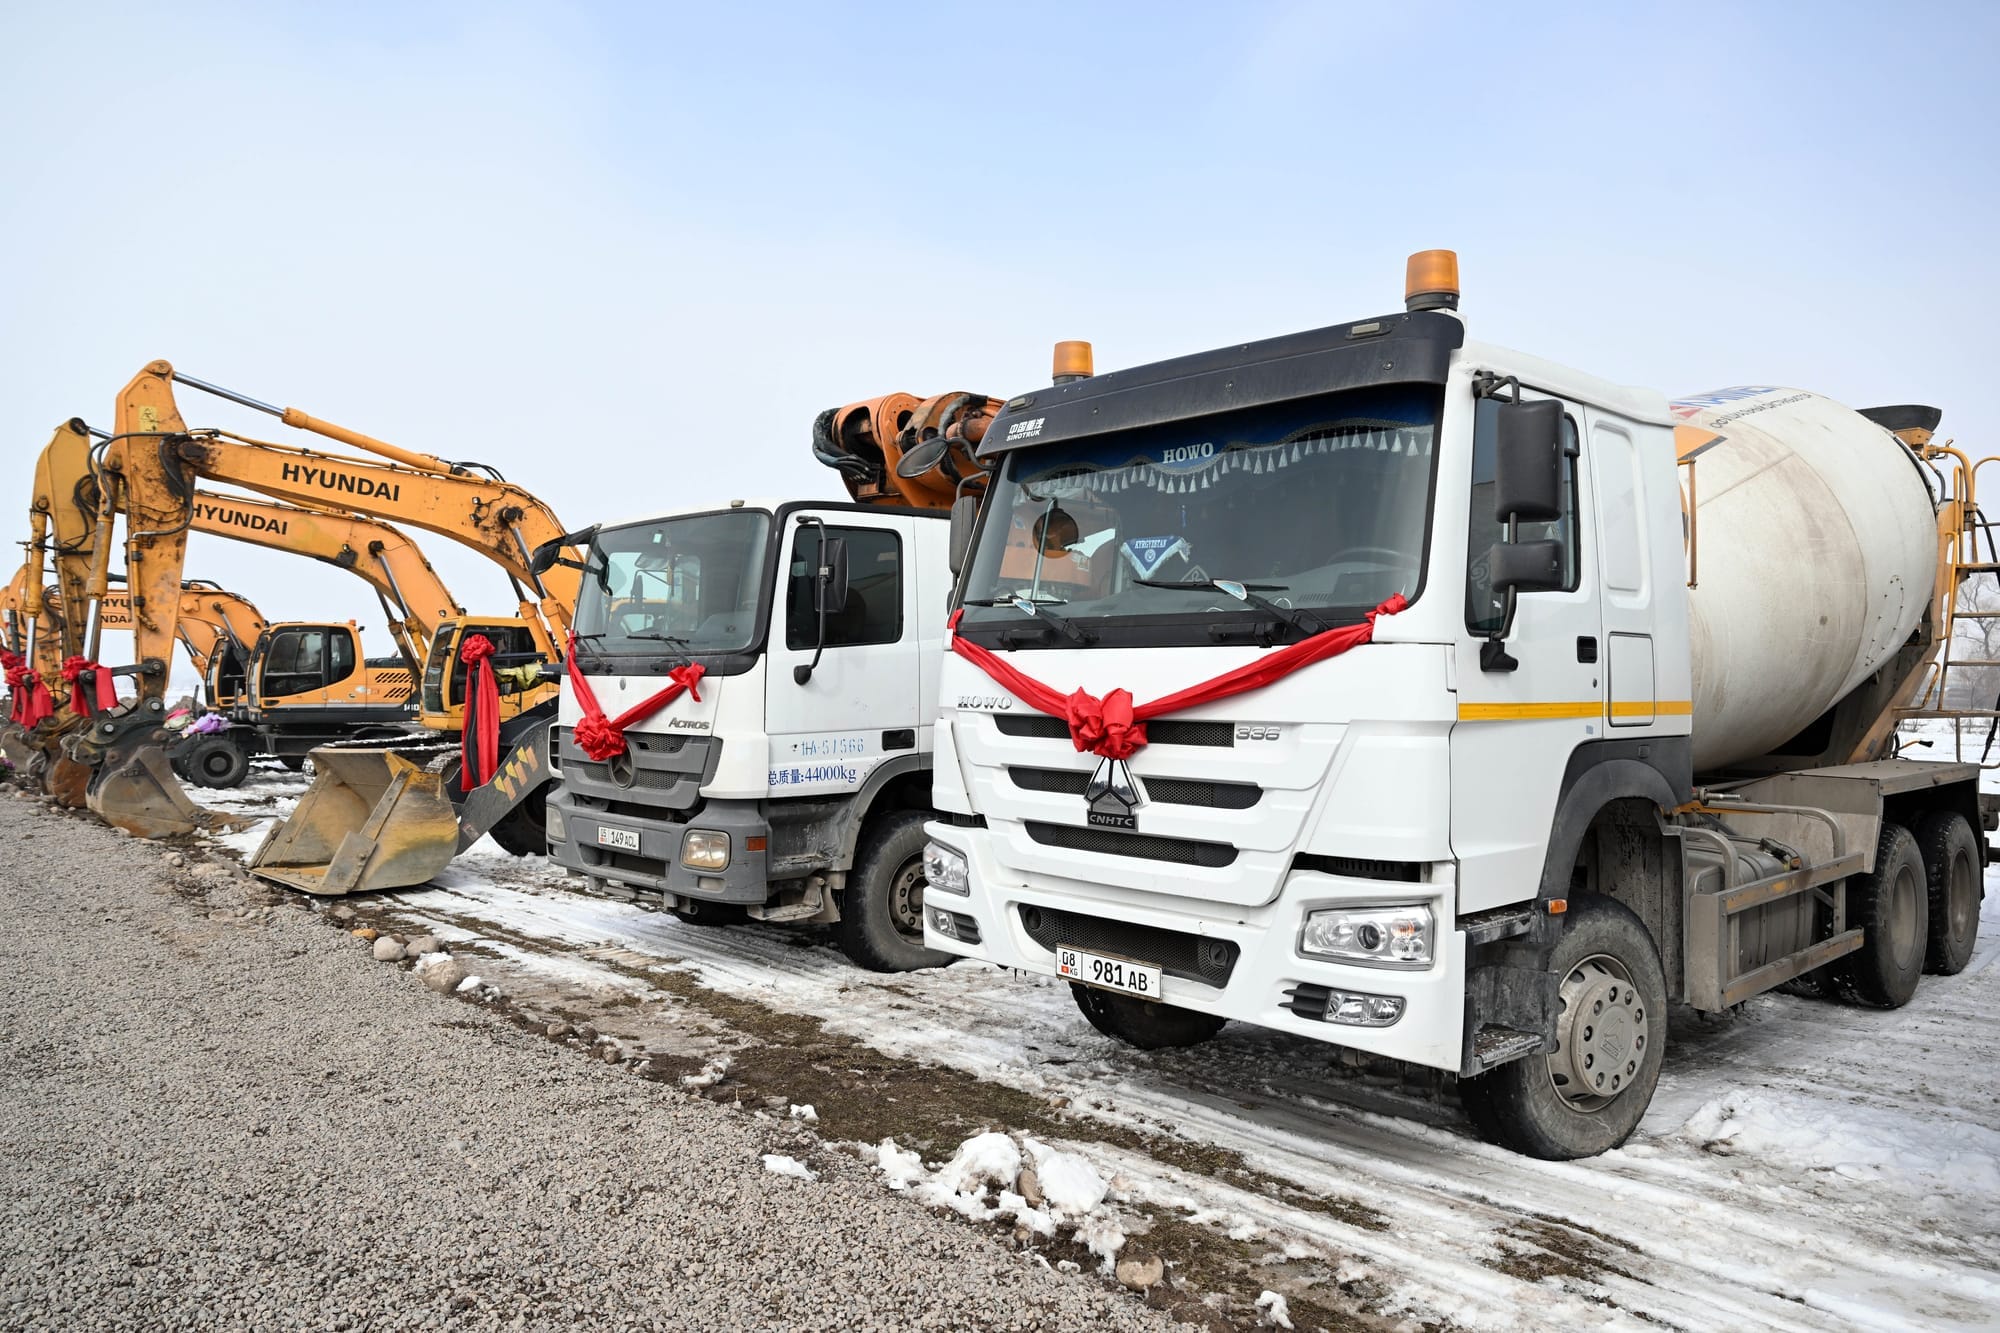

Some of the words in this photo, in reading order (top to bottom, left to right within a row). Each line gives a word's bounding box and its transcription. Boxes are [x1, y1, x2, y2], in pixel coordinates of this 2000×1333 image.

[1006, 429, 1041, 441] SINOTRUK
[1162, 442, 1214, 464] HOWO
[282, 462, 400, 502] HYUNDAI
[192, 503, 288, 536] HYUNDAI
[957, 696, 1013, 710] HOWO
[1236, 726, 1281, 741] 336
[1089, 814, 1134, 827] CNHTC
[611, 831, 625, 846] 149
[1062, 951, 1076, 967] 08
[1069, 967, 1079, 976] KG
[1093, 959, 1125, 987] 981
[1128, 970, 1148, 991] AB
